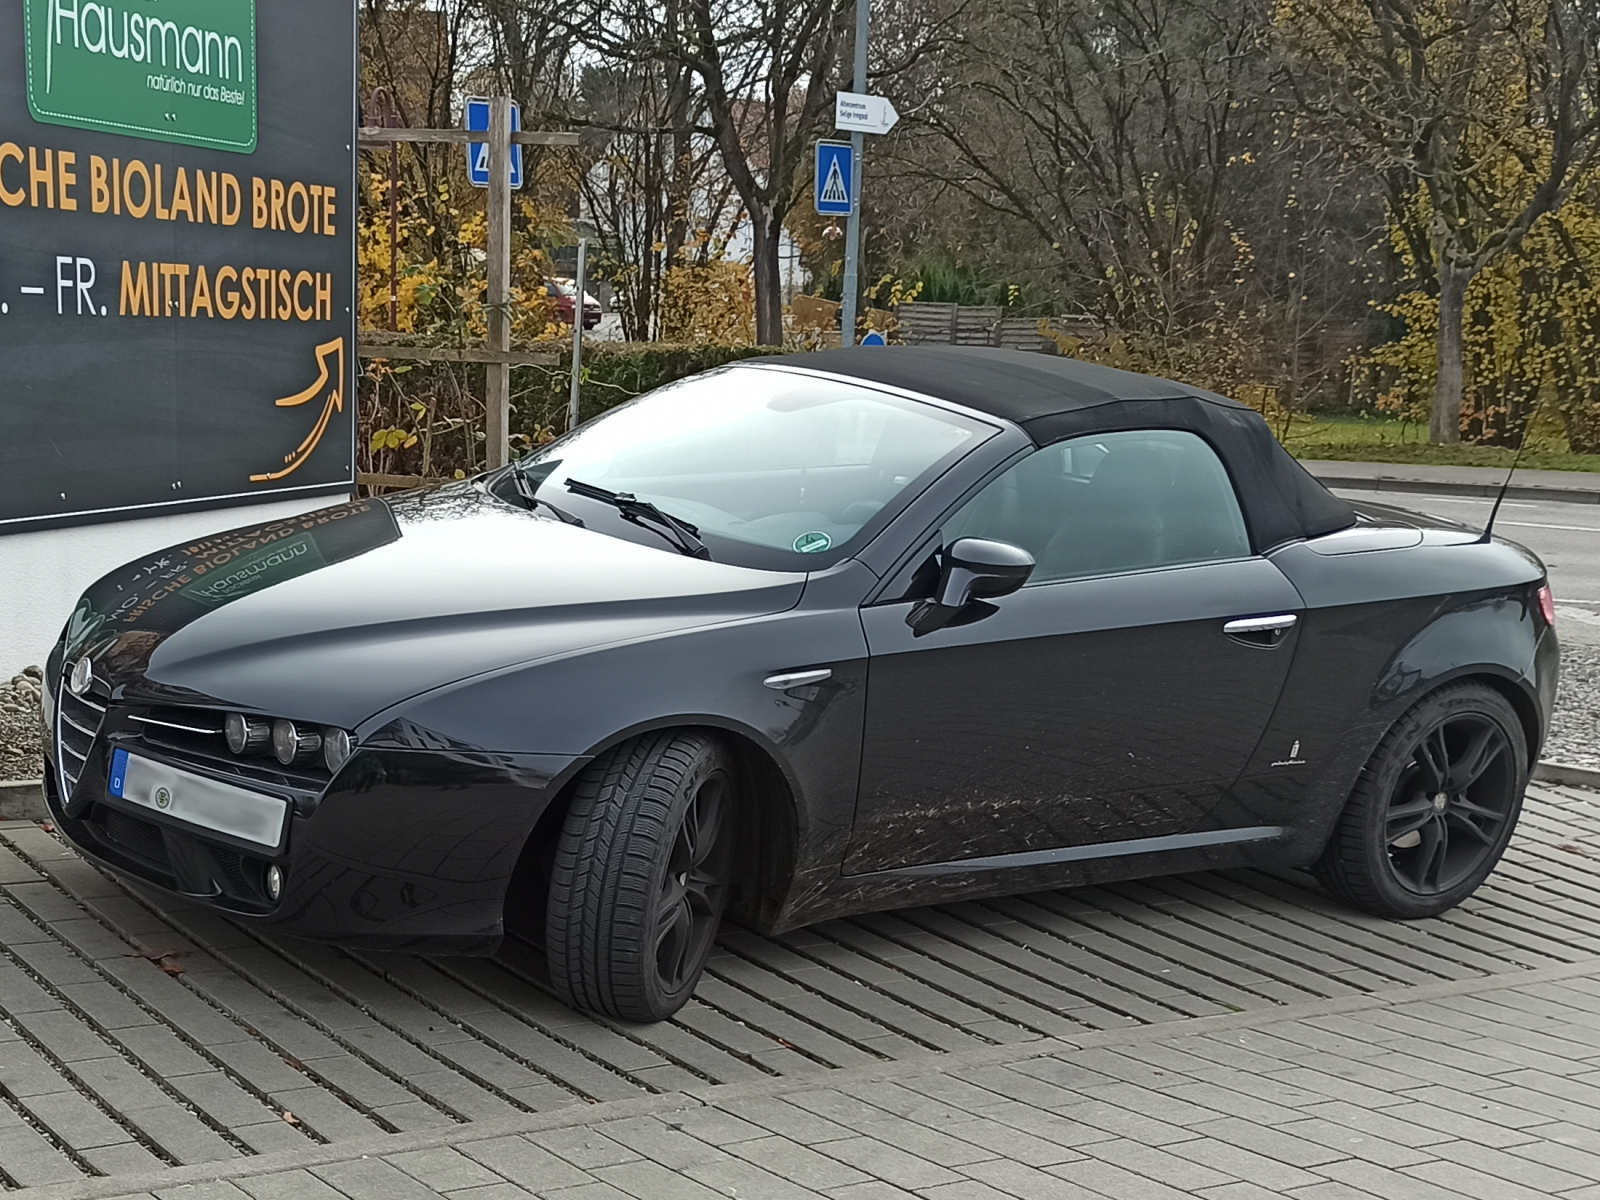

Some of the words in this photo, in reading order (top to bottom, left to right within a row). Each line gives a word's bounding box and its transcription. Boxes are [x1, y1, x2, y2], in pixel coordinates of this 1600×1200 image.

[55, 0, 243, 82] Hausmann
[146, 74, 186, 94] natürlich
[187, 83, 202, 97] nur
[203, 84, 219, 101] das
[220, 86, 245, 105] Beste!
[90, 155, 241, 225] BIOLAND
[252, 176, 337, 236] BROTE
[56, 256, 107, 317] FR.
[119, 260, 331, 321] MITTAGSTISCH
[114, 778, 120, 788] D
